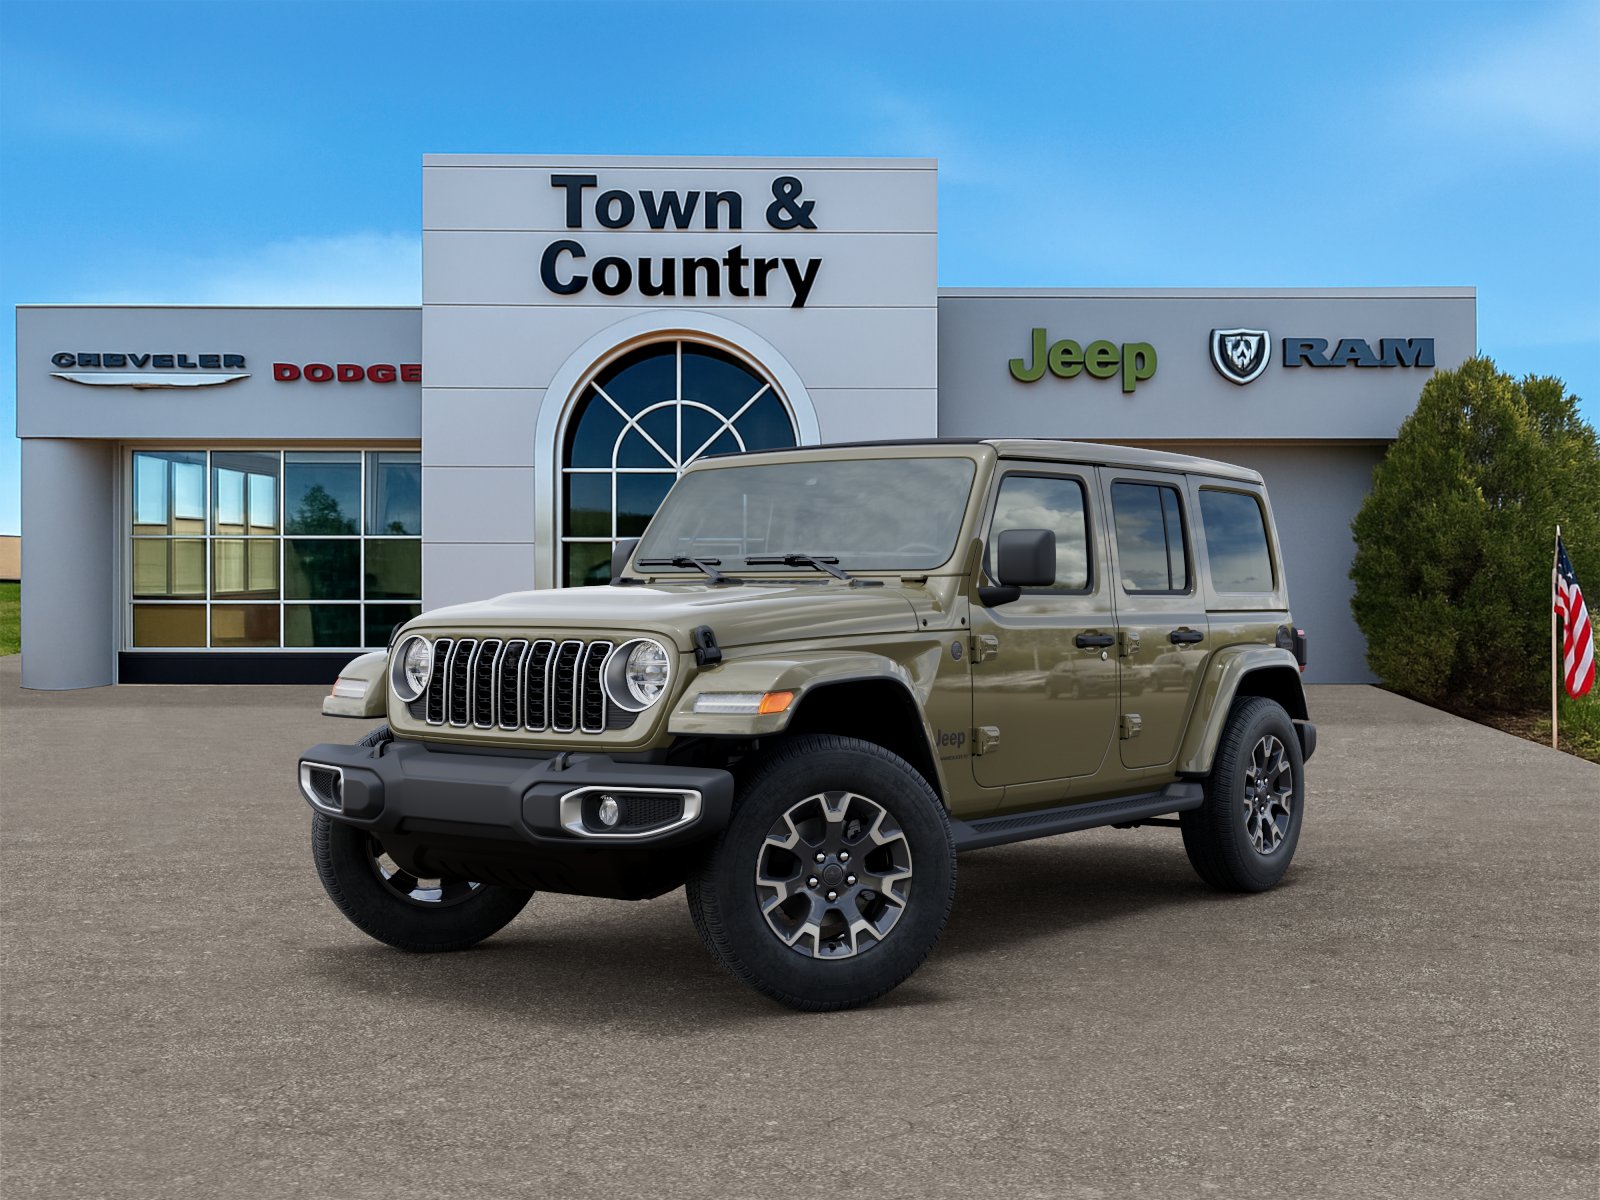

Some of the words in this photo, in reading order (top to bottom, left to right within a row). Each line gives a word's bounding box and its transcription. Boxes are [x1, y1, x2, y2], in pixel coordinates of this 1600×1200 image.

[550, 174, 743, 229] Town
[766, 176, 818, 229] &
[540, 239, 822, 308] Country
[273, 363, 422, 382] DODGE
[1009, 328, 1157, 393] Jeep
[1282, 337, 1435, 368] RAM
[937, 729, 965, 749] Jeep
